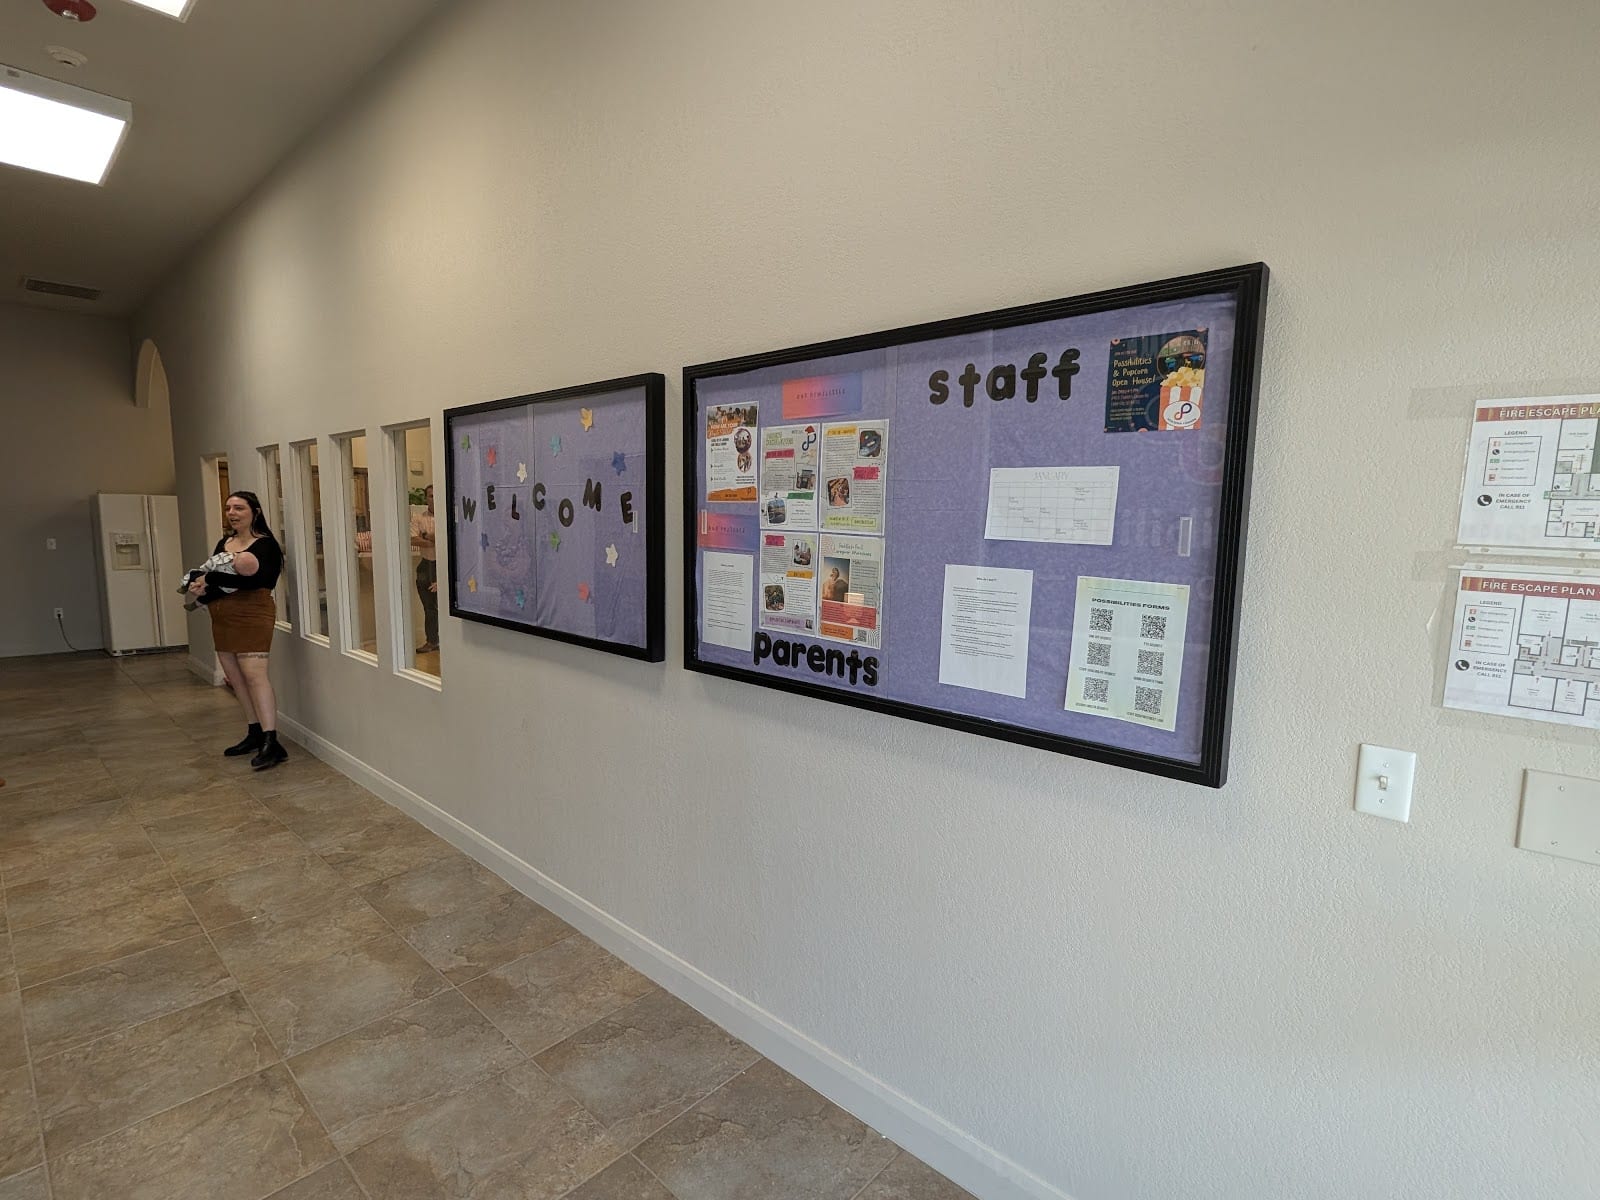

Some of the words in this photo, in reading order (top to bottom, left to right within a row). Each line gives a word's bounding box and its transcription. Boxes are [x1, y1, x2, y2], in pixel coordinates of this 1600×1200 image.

[1113, 357, 1152, 367] Possibilities
[928, 348, 1081, 408] staff
[1112, 369, 1120, 377] &
[1123, 368, 1148, 376] Popcorn
[1112, 379, 1128, 387] Open
[1132, 374, 1156, 385] House!
[1499, 409, 1525, 418] FIRE
[1528, 407, 1577, 417] ESCAPE
[1033, 471, 1070, 481] JANUARY
[462, 478, 634, 528] WELCOME
[1482, 581, 1509, 590] FIRE
[1511, 583, 1558, 593] ESCAPE
[1561, 585, 1595, 596] PLAN
[1091, 597, 1142, 608] POSSIBILITIES
[1142, 603, 1171, 611] FORMS
[753, 631, 880, 687] parents
